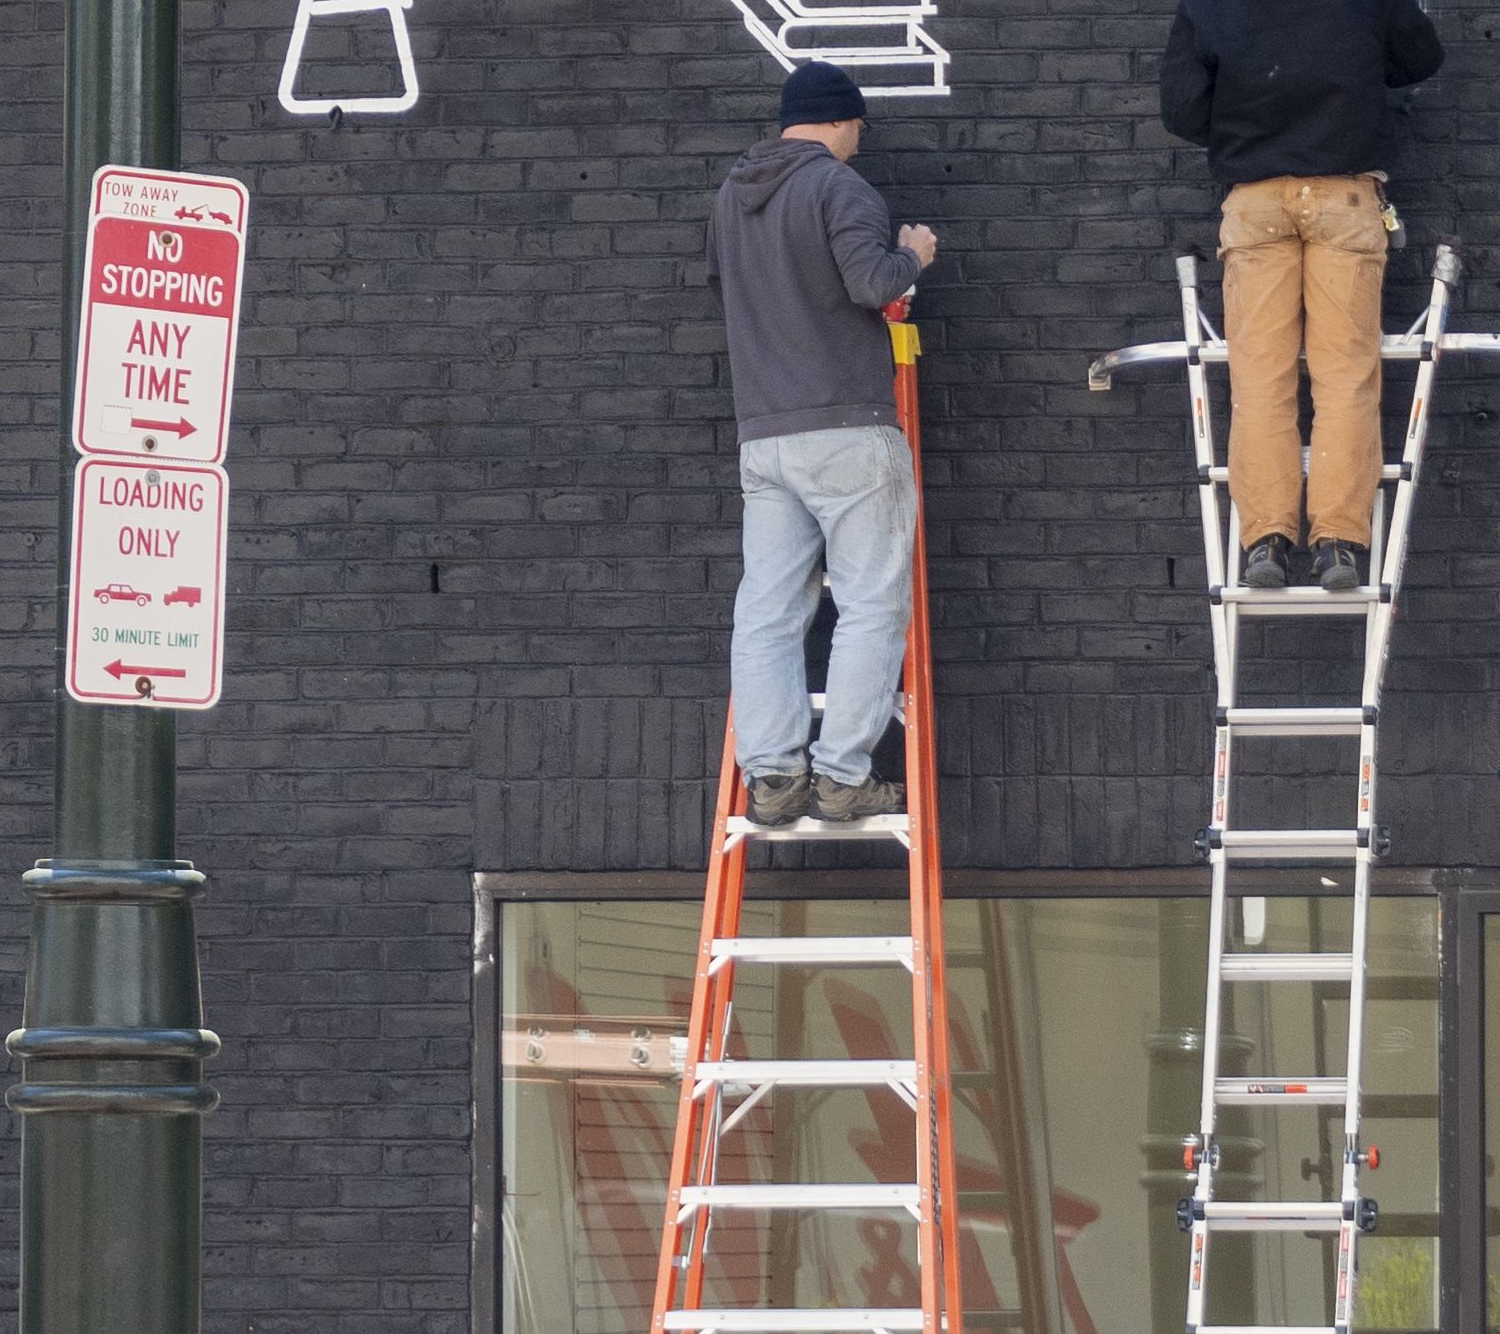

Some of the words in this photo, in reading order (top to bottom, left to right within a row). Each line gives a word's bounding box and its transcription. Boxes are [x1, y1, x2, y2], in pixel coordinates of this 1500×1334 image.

[104, 181, 134, 198] TOW
[140, 185, 179, 203] AWAY
[123, 201, 157, 218] ZONE
[147, 230, 184, 263] NO
[101, 263, 224, 307] STOPPING
[126, 318, 192, 361] ANY
[121, 362, 192, 405] TIME
[99, 476, 205, 513] LOADING
[119, 526, 181, 559] ONLY
[92, 626, 109, 644] 30
[114, 628, 162, 647] MINUTE
[167, 630, 200, 648] LIMIT
